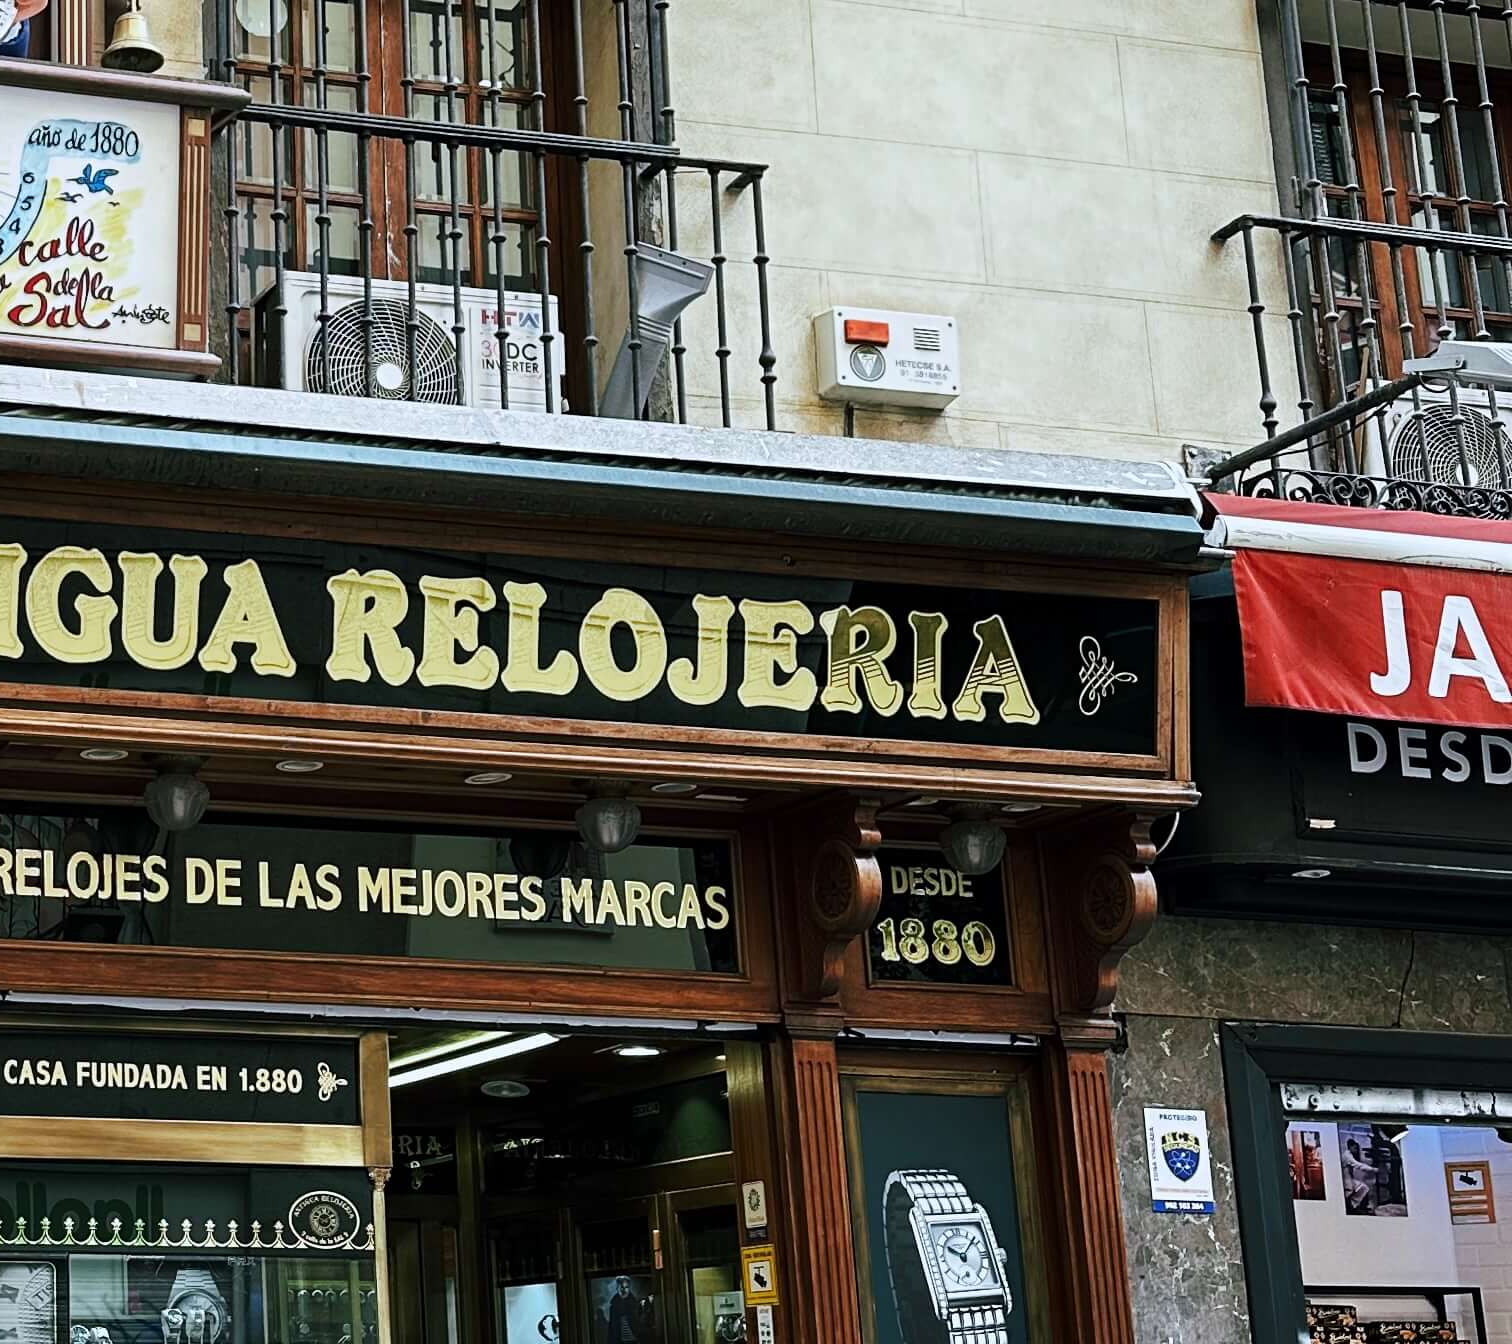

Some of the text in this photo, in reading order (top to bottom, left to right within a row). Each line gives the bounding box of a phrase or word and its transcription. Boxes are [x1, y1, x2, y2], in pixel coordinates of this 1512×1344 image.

[65, 129, 86, 151] de
[90, 123, 139, 156] 1880
[20, 196, 34, 210] 5
[23, 172, 35, 184] 6
[9, 217, 21, 234] 4
[19, 216, 108, 267] calle
[7, 271, 111, 329] Sal
[325, 567, 1040, 726] RELOJERIA
[1369, 589, 1512, 704] JA
[1347, 722, 1512, 785] DESD
[185, 855, 243, 907] DE
[258, 861, 342, 912] LAS
[358, 868, 544, 923] MEJORES
[561, 876, 730, 932] MARCAS
[890, 864, 973, 898] DESDE
[879, 916, 996, 967] 1880
[3, 1060, 303, 1094] CASA FUNDADA EN 1.880
